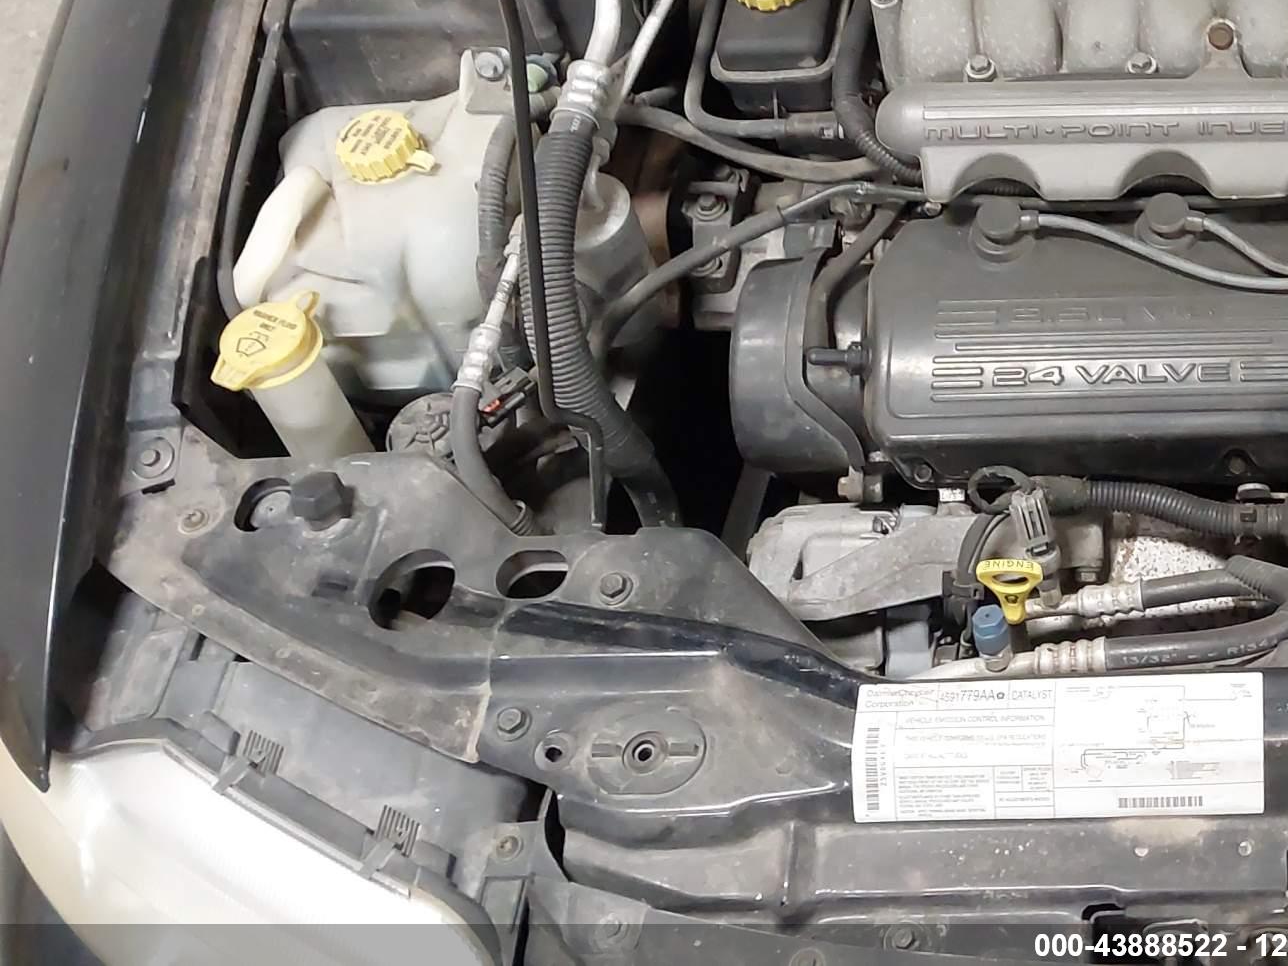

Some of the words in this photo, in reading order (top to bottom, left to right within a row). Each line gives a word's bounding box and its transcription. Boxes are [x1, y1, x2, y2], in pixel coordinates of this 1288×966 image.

[992, 366, 1064, 386] 24
[1075, 363, 1231, 384] VALVE
[983, 560, 1034, 571] ENGINE
[1011, 689, 1053, 701] CATALYST
